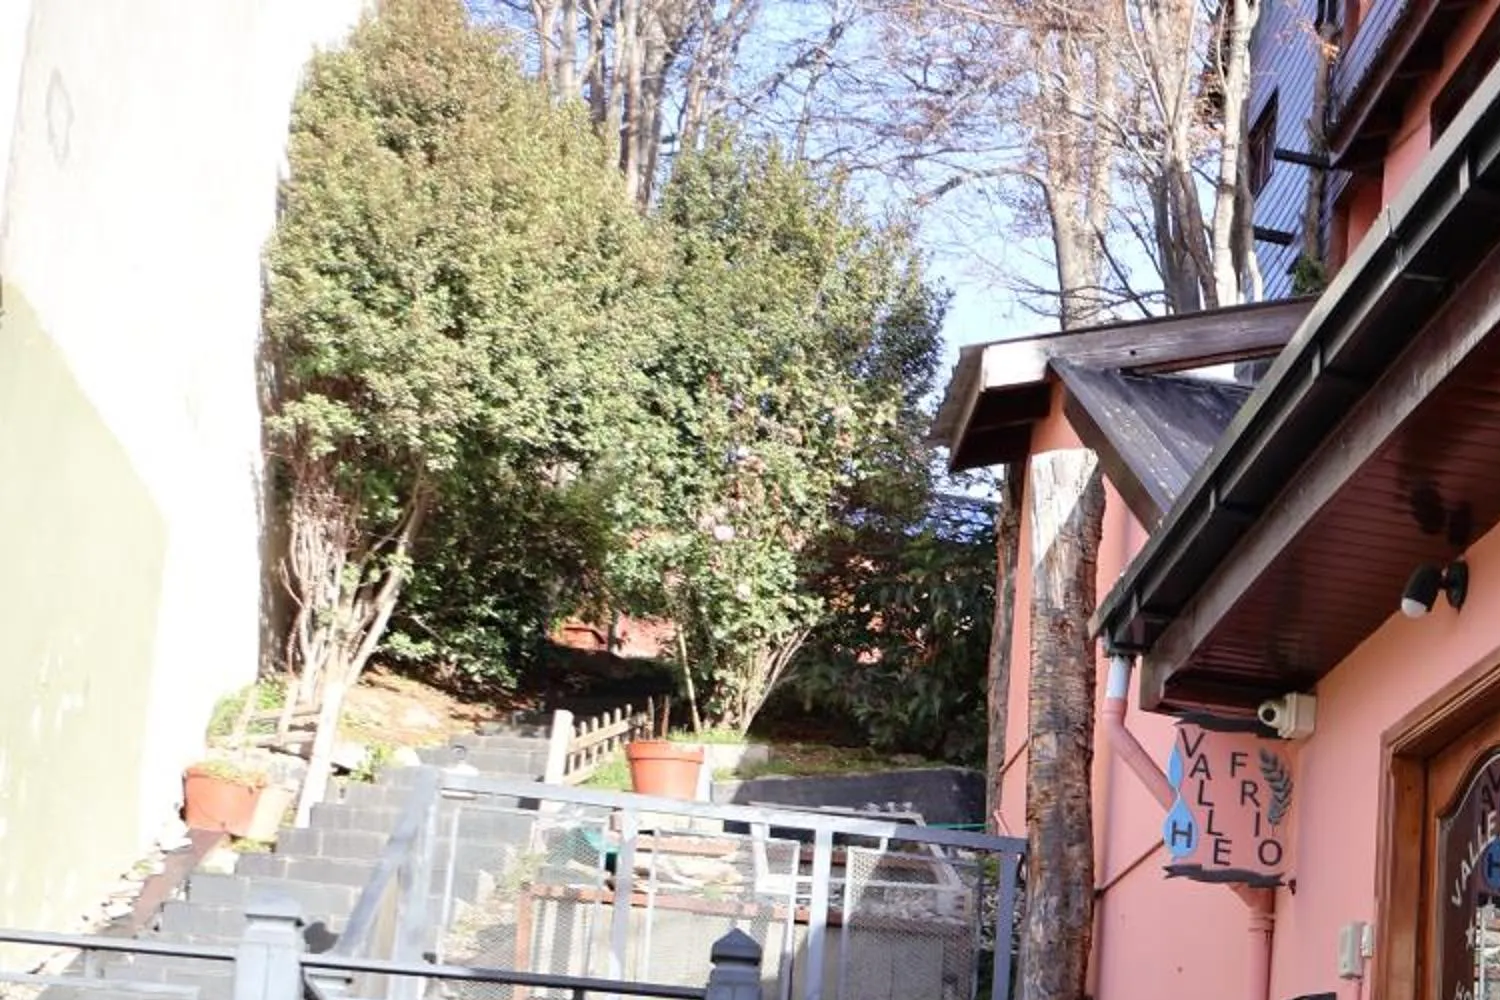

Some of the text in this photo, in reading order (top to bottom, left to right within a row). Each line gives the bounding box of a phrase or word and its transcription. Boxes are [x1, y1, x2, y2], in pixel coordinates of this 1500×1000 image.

[1171, 821, 1194, 848] H
[1180, 727, 1233, 866] VALLE
[1230, 751, 1283, 866] FRIO
[1451, 810, 1498, 907] VALLE
